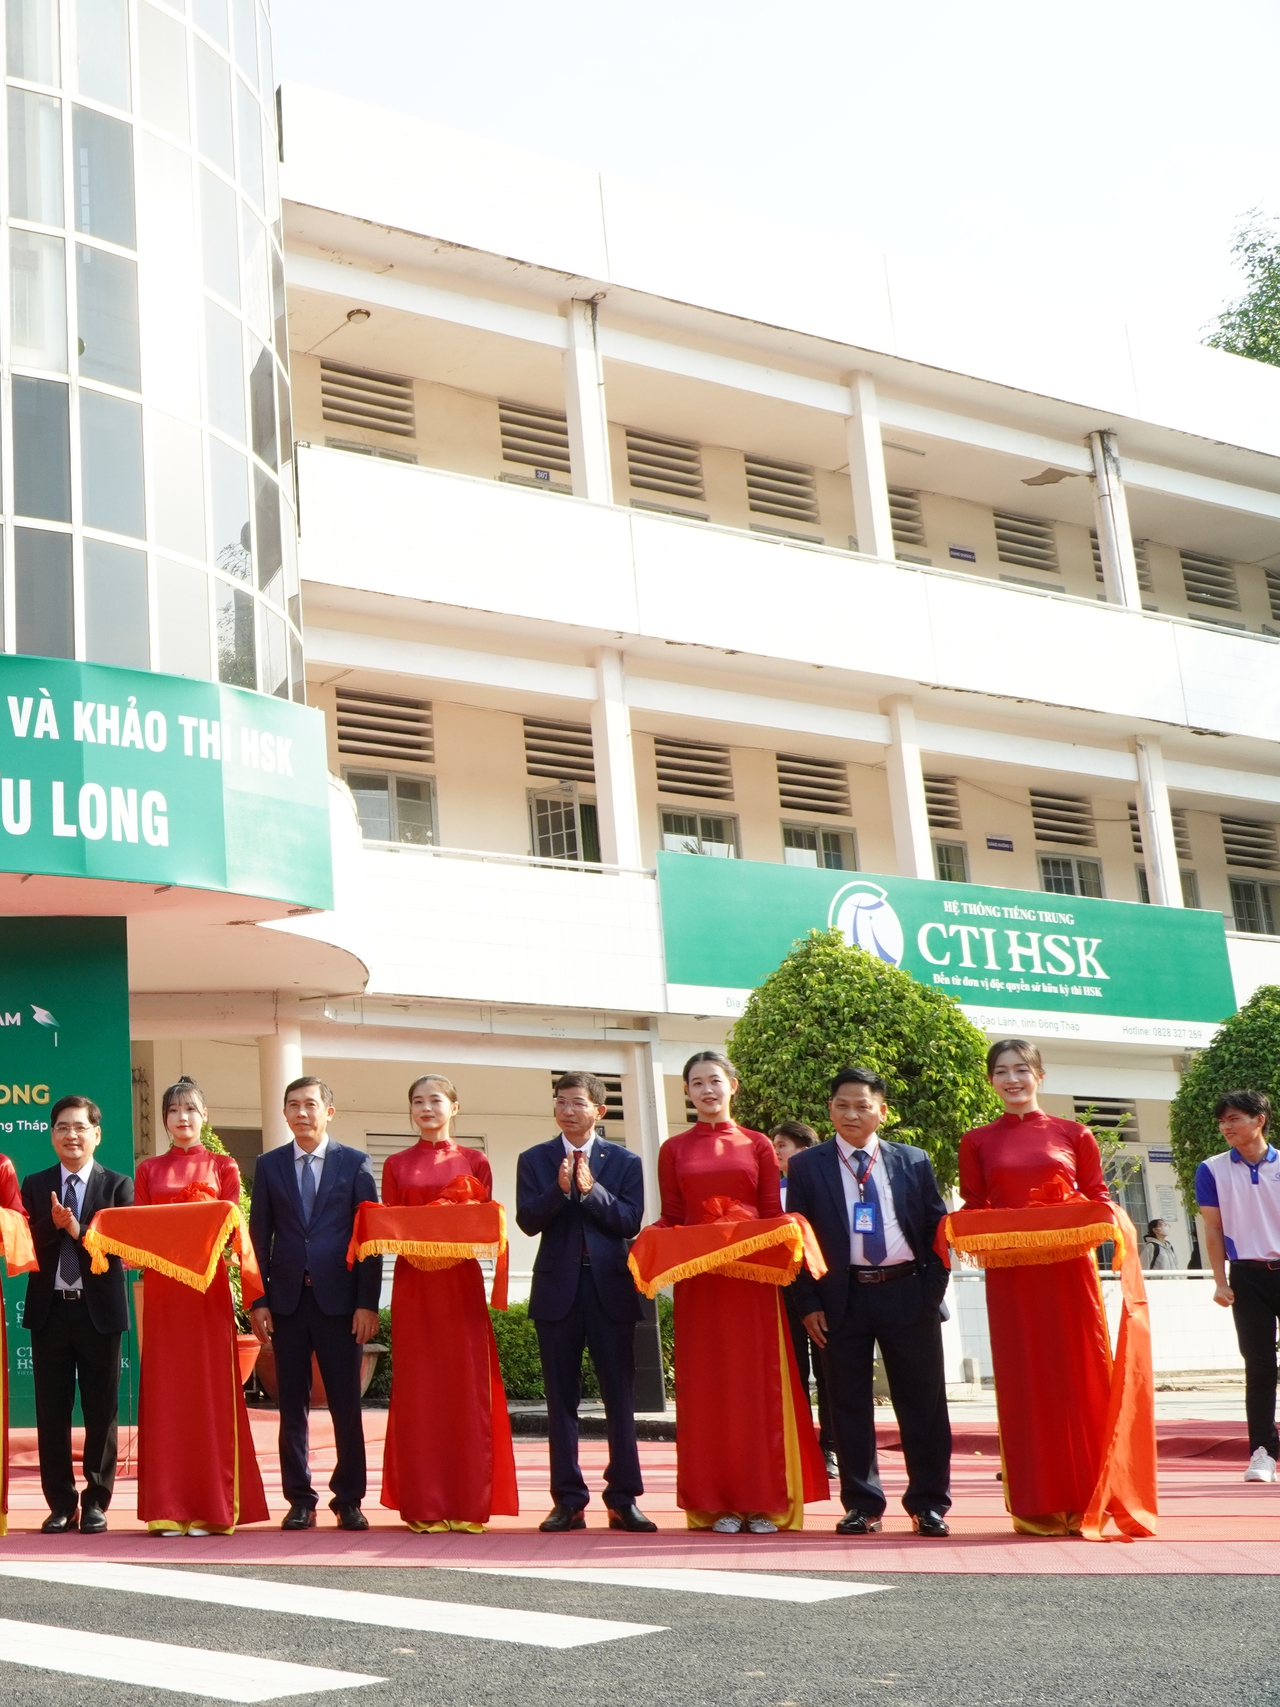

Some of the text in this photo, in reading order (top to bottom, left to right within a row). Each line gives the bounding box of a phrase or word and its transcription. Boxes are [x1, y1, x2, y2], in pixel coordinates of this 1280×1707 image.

[7, 687, 60, 740] VÀ
[74, 695, 167, 753] KHẢO
[178, 709, 232, 763] THÍ
[240, 726, 294, 777] HSK
[52, 780, 169, 848] LONG
[943, 900, 960, 916] HỆ
[1037, 910, 1075, 925] TRUNG
[917, 922, 1110, 979] CTI HSK
[1083, 986, 1103, 997] HSK
[980, 1015, 995, 1025] Cao
[1173, 1028, 1186, 1038] 327
[1189, 1029, 1202, 1039] 269
[17, 1120, 48, 1132] Tháp
